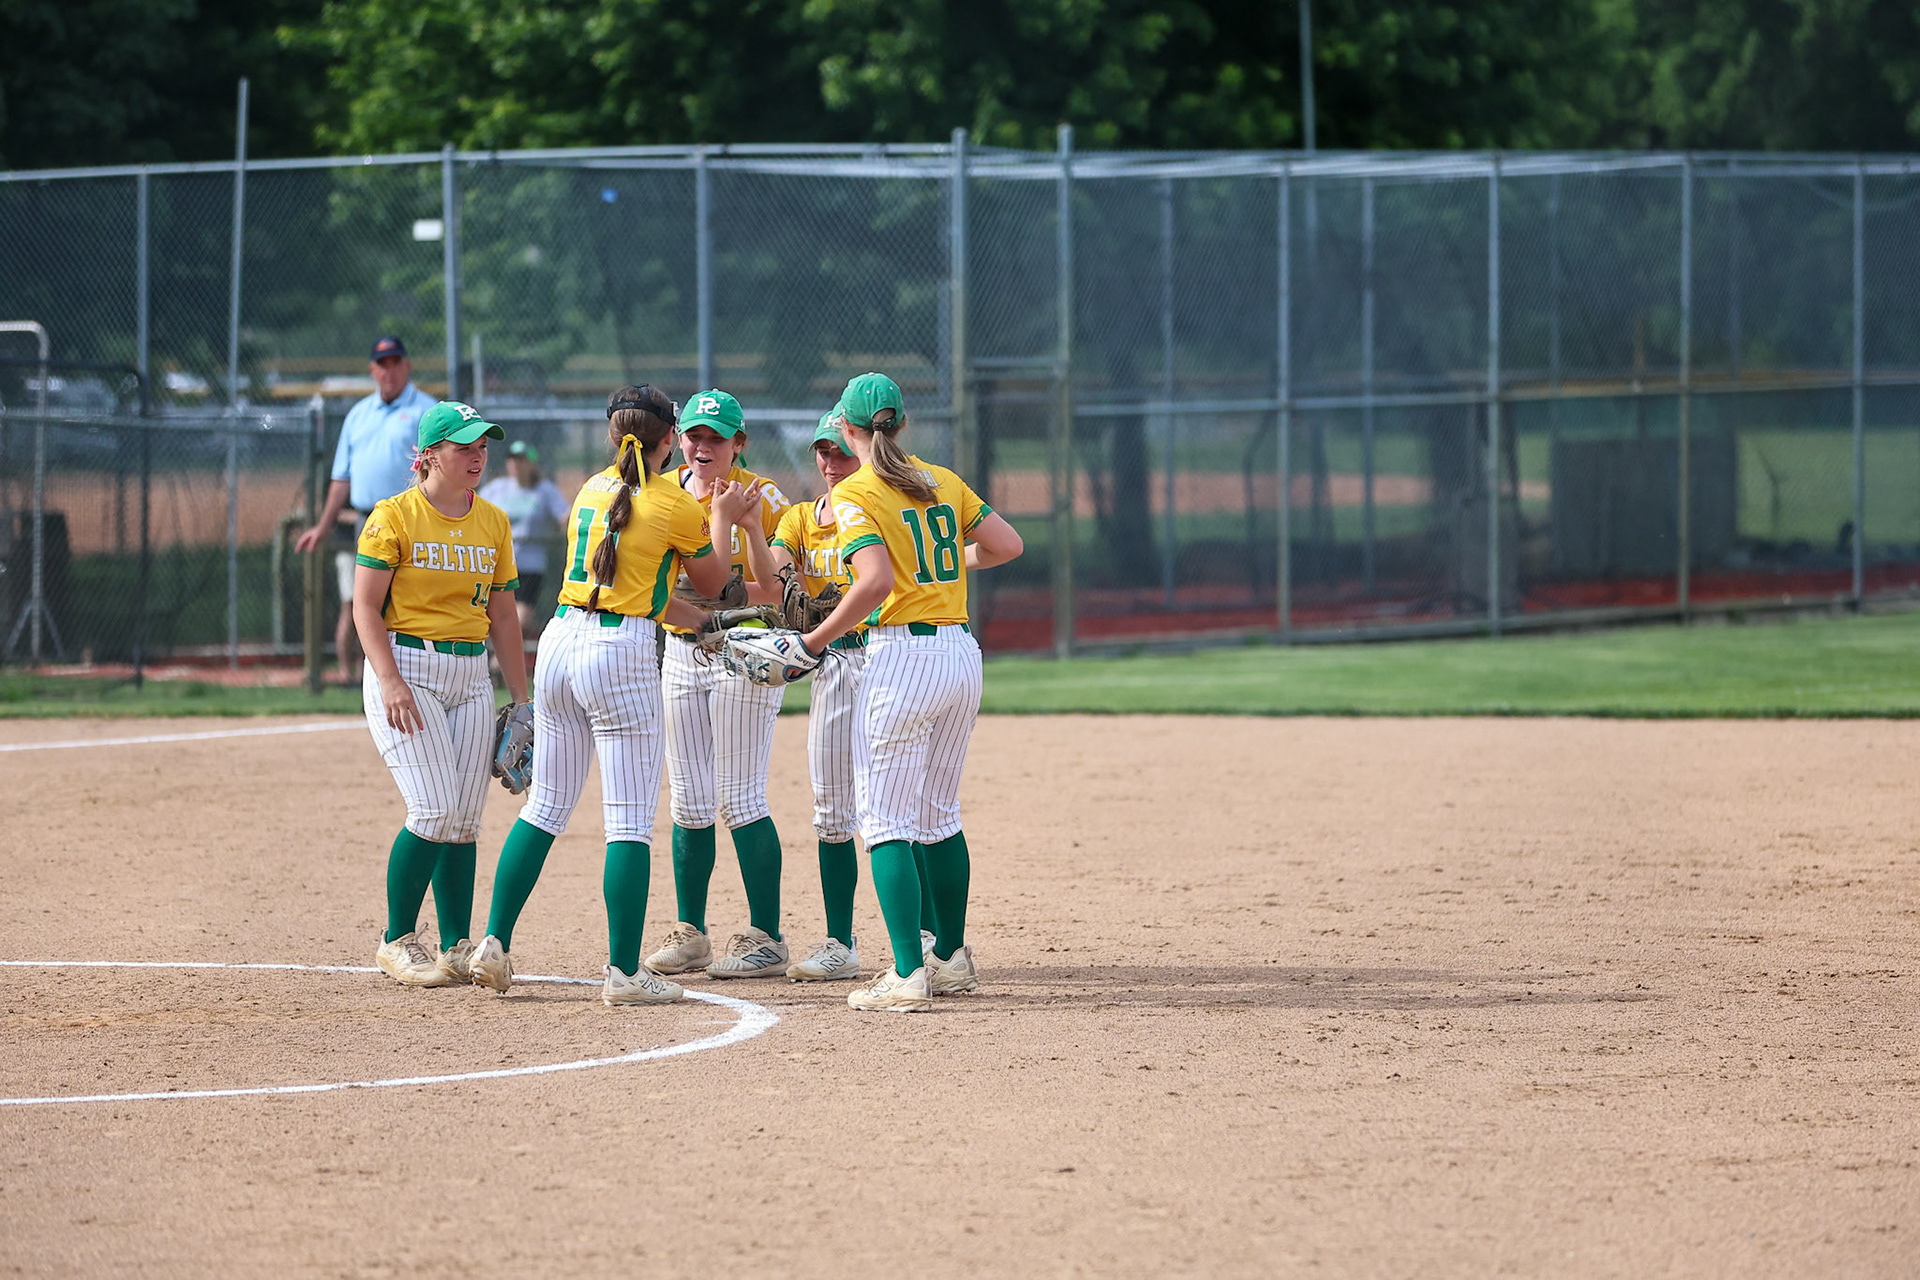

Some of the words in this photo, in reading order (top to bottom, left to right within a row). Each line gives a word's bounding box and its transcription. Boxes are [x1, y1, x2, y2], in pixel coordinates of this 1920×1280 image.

[694, 397, 720, 415] PC
[412, 541, 497, 574] CELTICS
[900, 503, 960, 585] 18
[800, 544, 845, 578] ELTI
